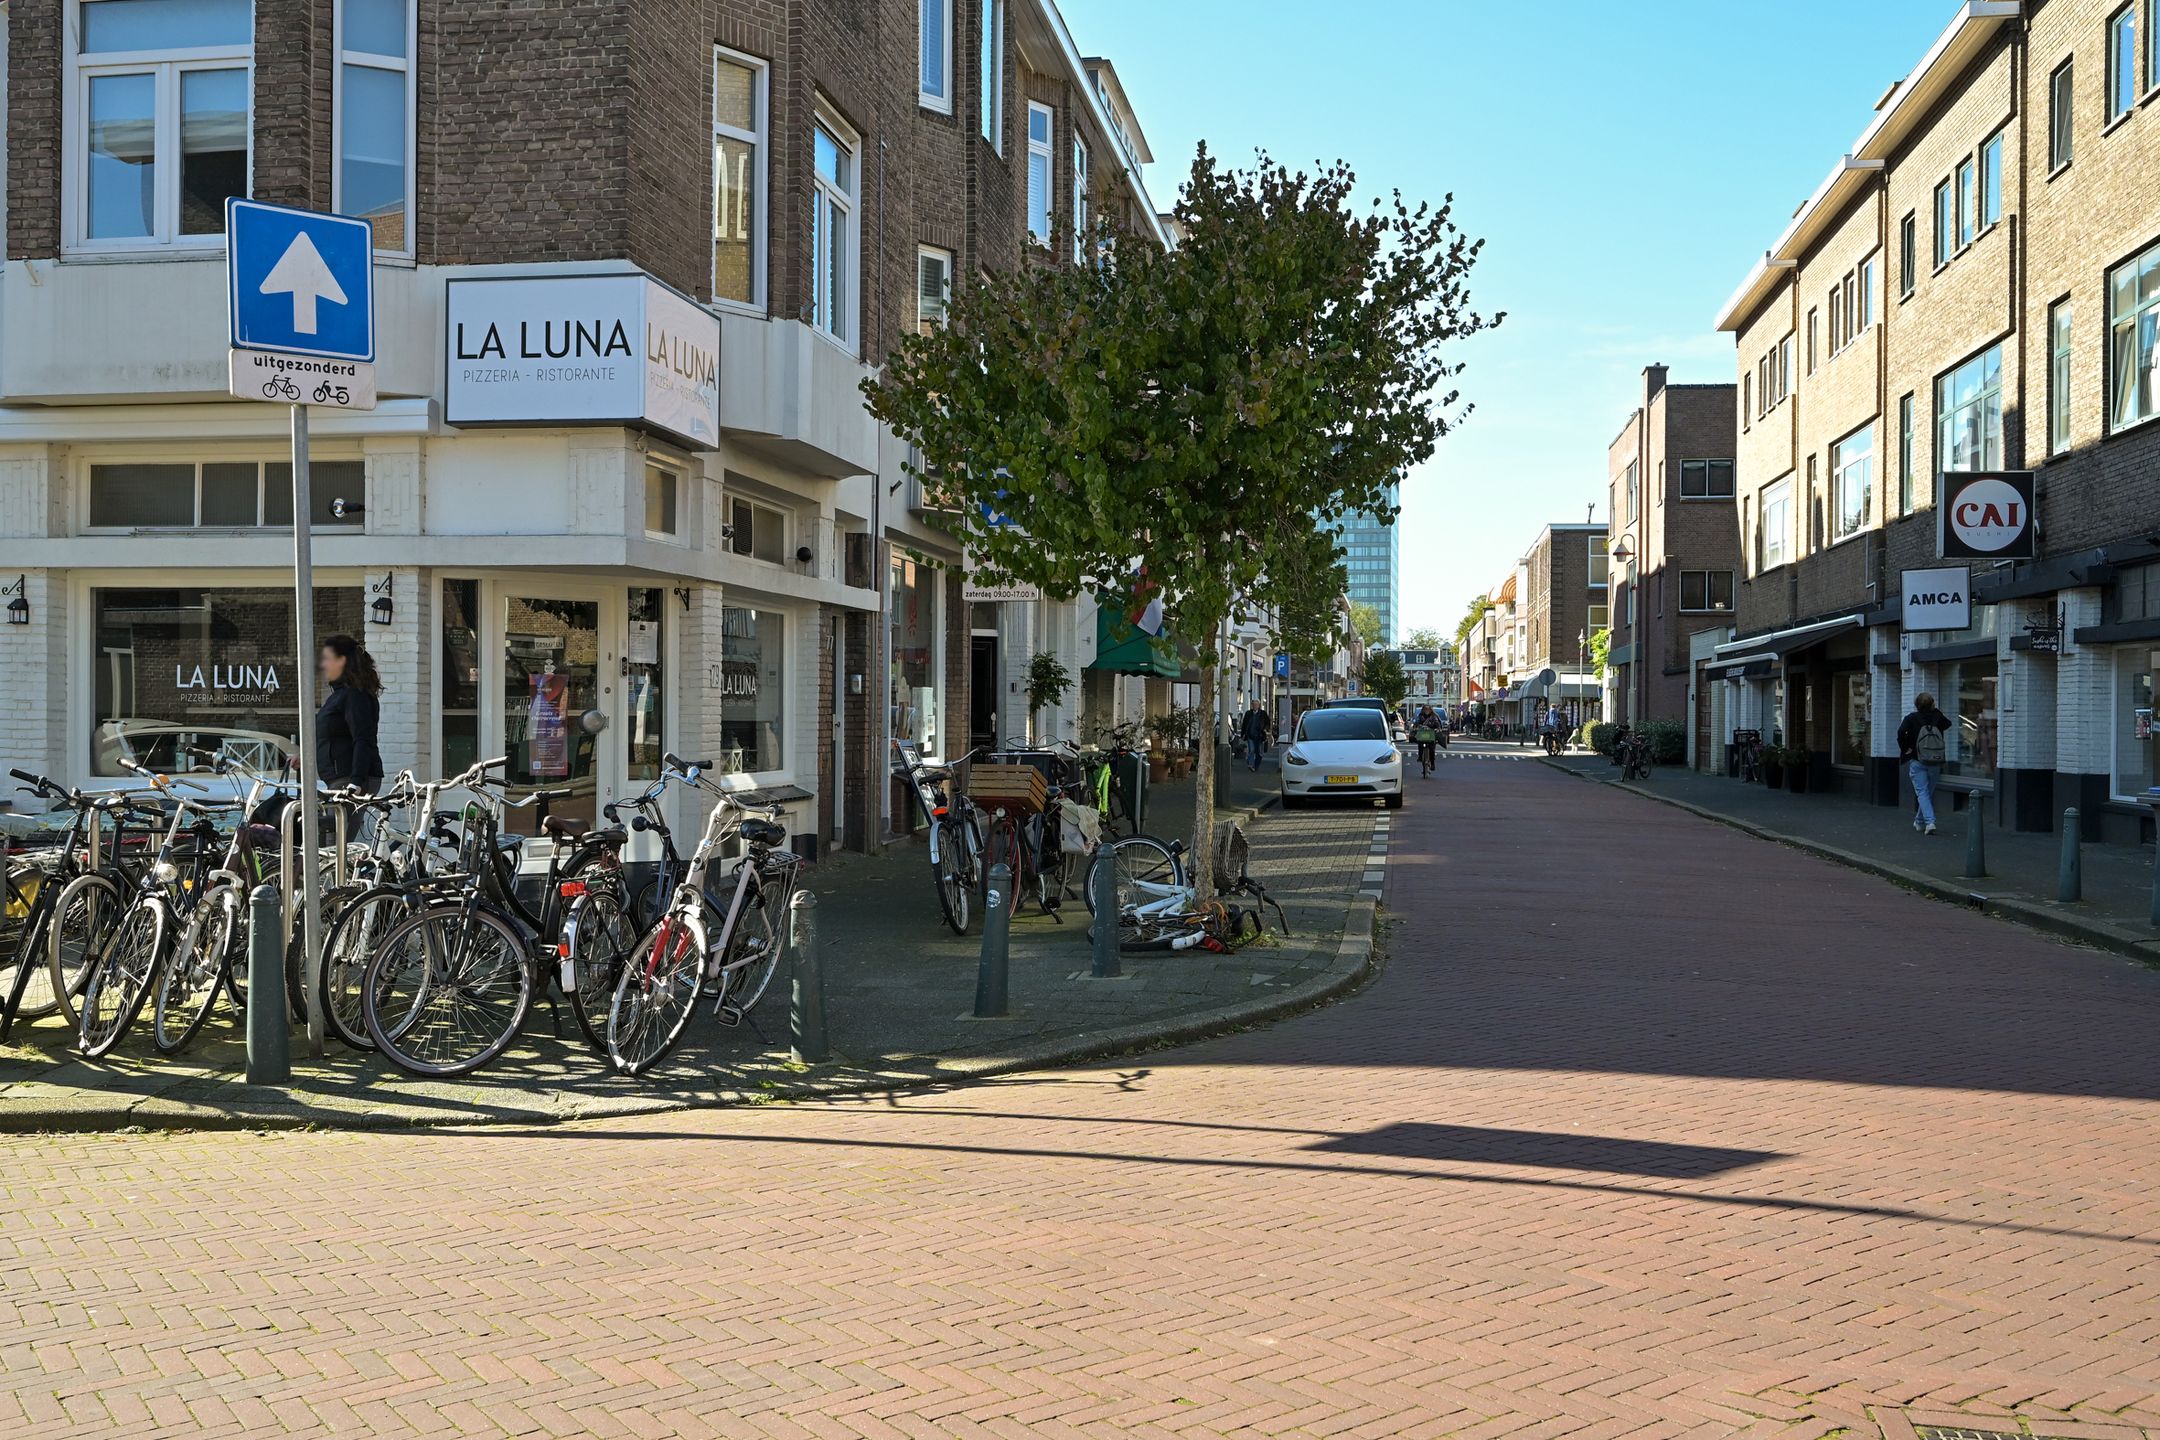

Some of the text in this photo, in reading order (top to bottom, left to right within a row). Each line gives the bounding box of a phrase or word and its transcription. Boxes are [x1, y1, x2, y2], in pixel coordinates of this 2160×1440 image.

[456, 318, 632, 360] LA LUNA
[253, 354, 356, 376] uitgezonderd
[648, 322, 717, 391] LA LUNA
[463, 368, 520, 383] PIZZERIA
[536, 367, 615, 382] RISTORANTE
[1956, 502, 2020, 528] CAI
[965, 591, 992, 599] zaterdag
[1909, 591, 1963, 606] AMCA
[826, 635, 834, 650] 77
[1278, 660, 1285, 671] P
[176, 664, 280, 689] LA LUNA
[722, 674, 757, 695] LA LUNA
[180, 693, 214, 703] PIZZERIA
[223, 693, 271, 703] RISTORANTE
